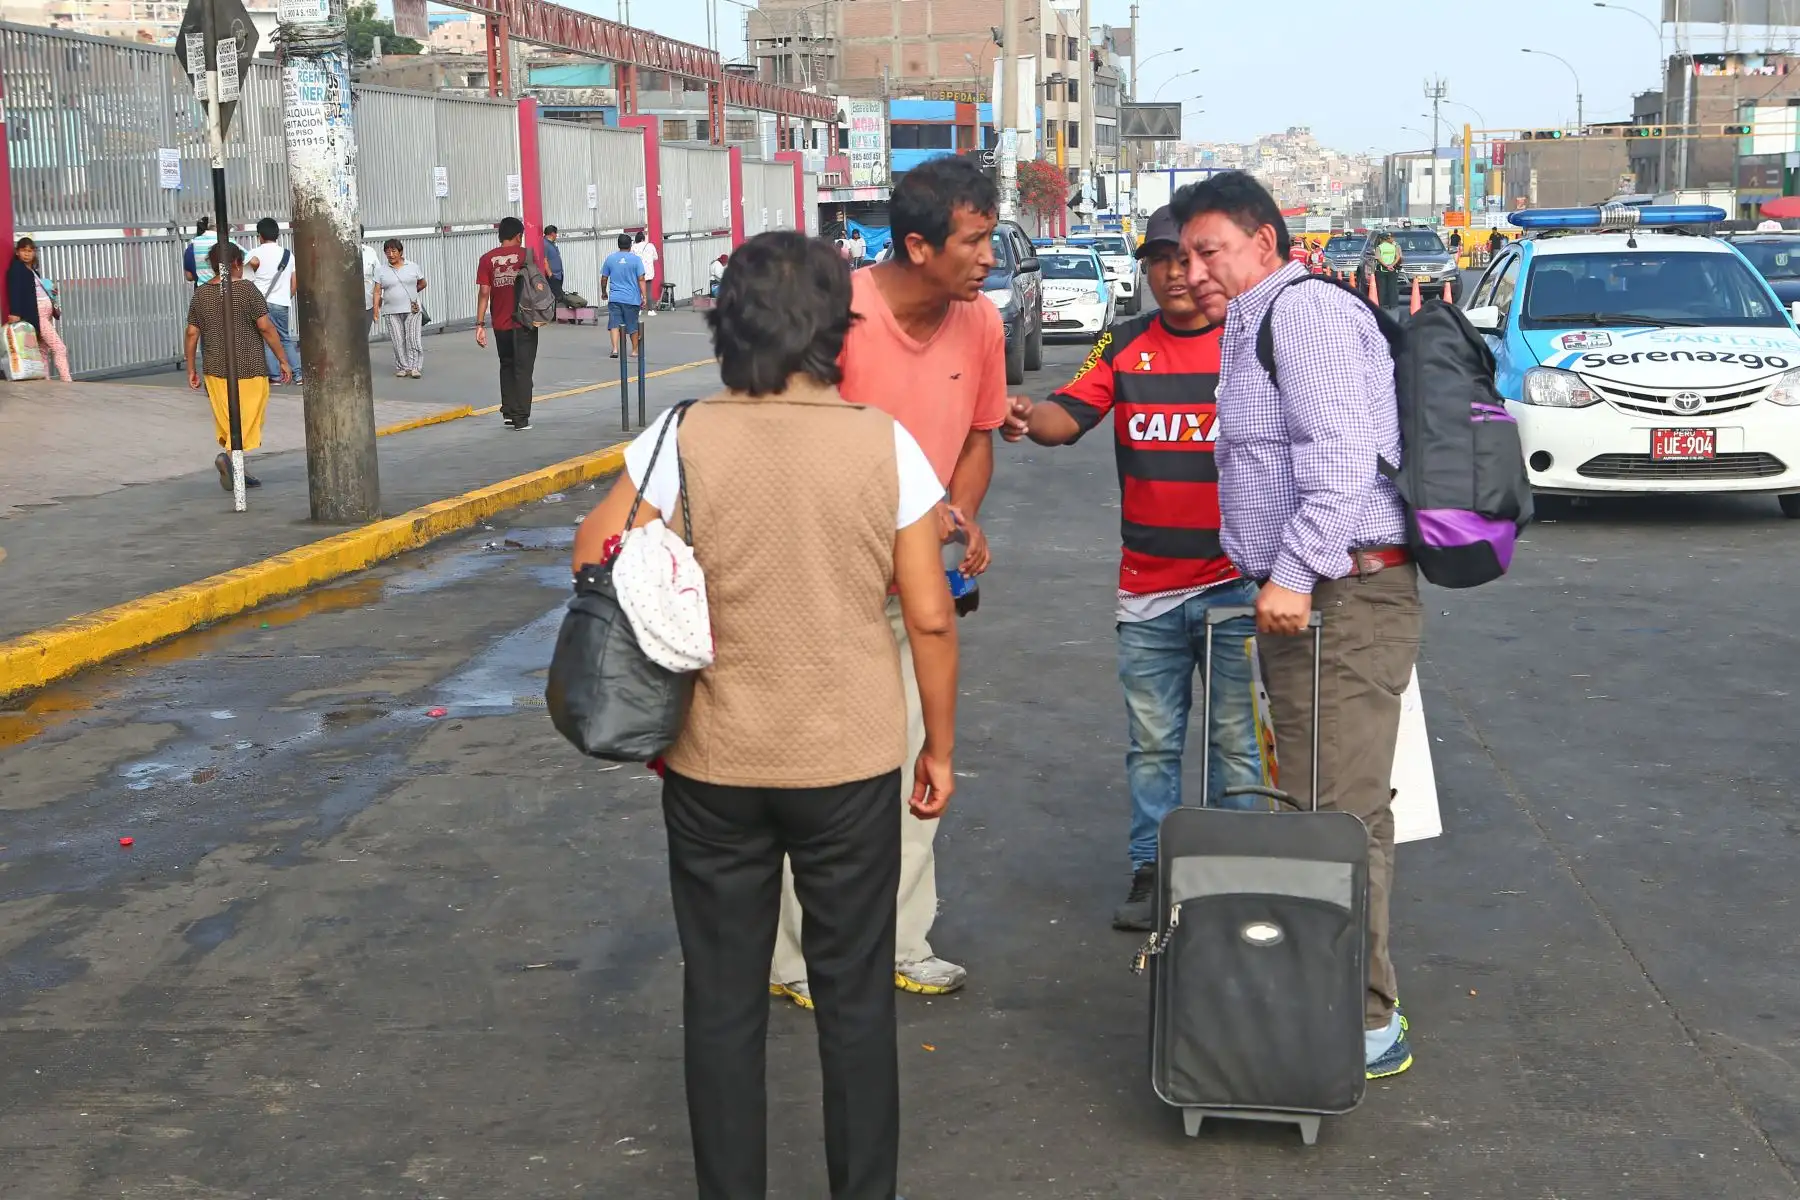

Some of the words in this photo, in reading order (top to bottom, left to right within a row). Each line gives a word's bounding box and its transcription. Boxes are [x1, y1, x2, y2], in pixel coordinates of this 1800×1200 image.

[1581, 350, 1789, 370] Serenazgo
[1128, 413, 1220, 442] CAIXA
[1664, 436, 1713, 454] UE-904
